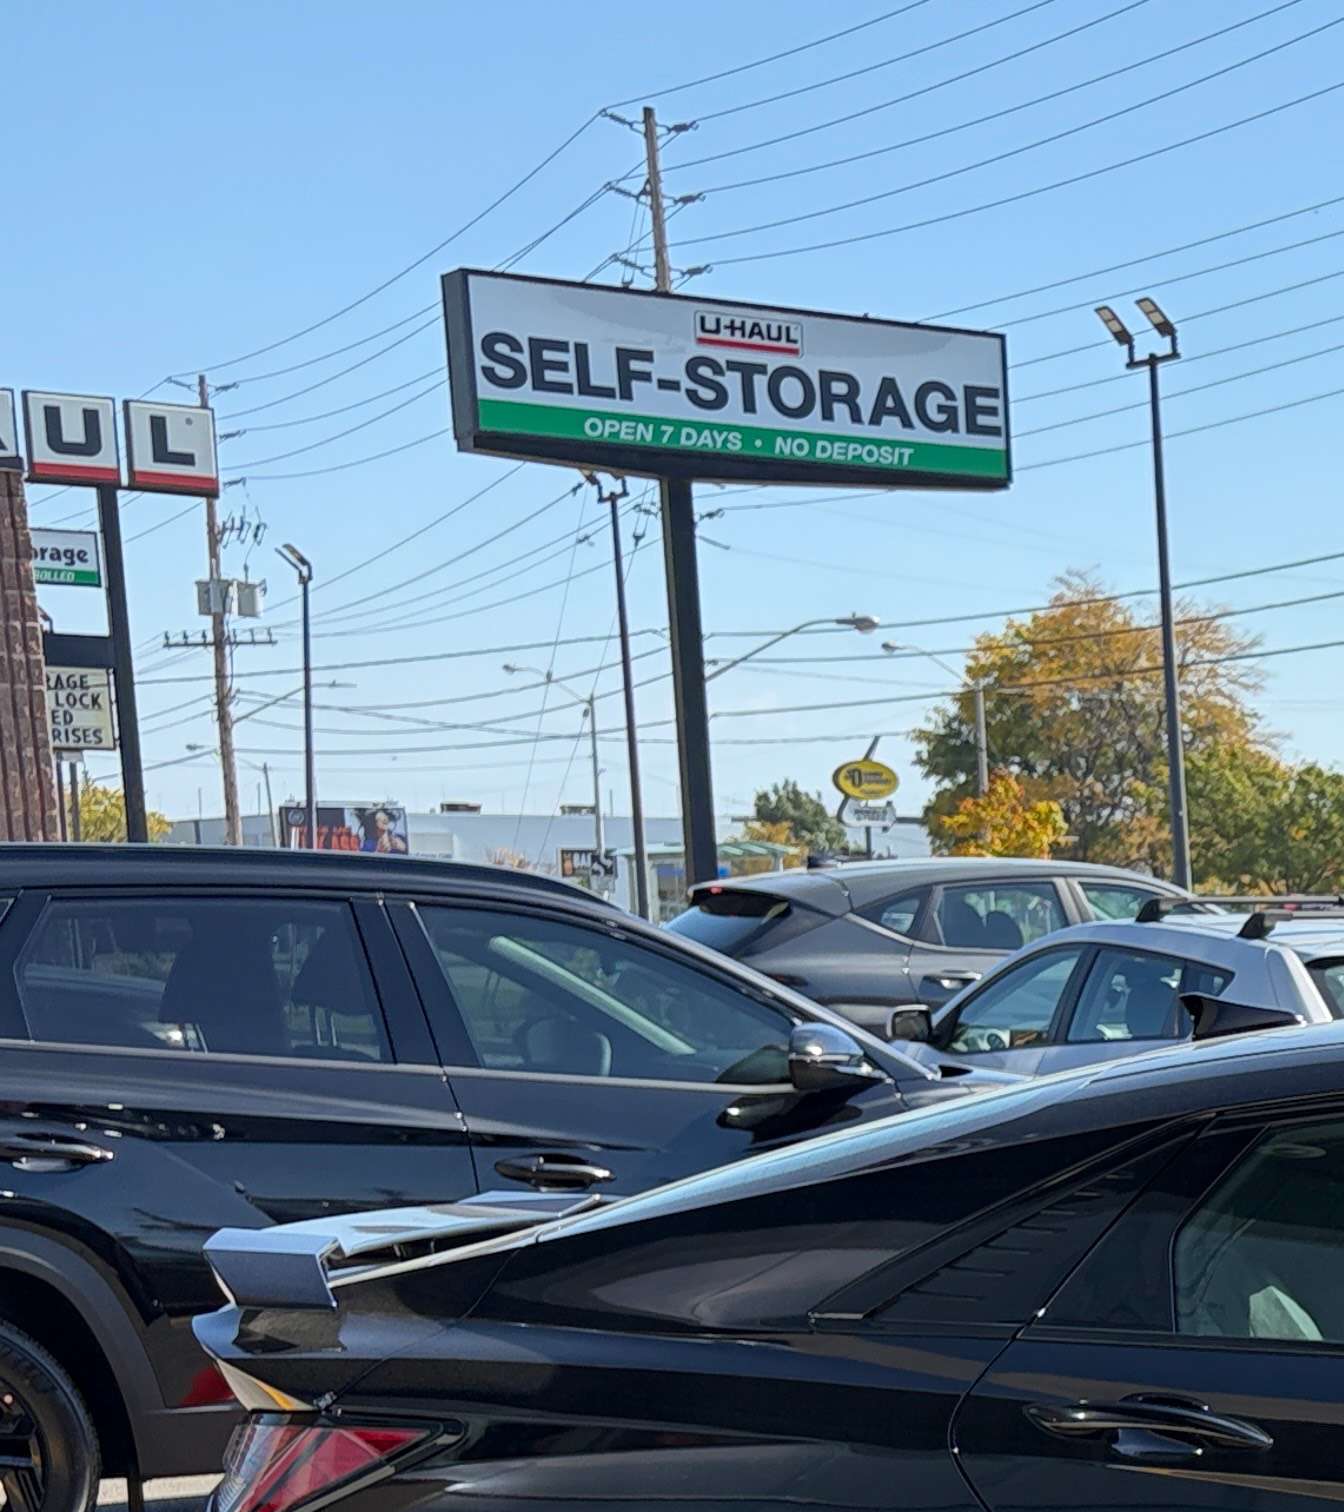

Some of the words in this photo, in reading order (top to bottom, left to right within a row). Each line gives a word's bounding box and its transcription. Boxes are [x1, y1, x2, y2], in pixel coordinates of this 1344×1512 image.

[699, 315, 800, 345] U-HAUL
[479, 332, 1003, 438] SELF-STORAGE
[584, 416, 654, 444] OPEN
[660, 424, 676, 445] 7
[680, 424, 742, 451] DAYS
[774, 436, 810, 457] NO
[815, 439, 915, 467] DEPOSIT
[32, 544, 89, 567] orage
[54, 691, 103, 710] LOCK
